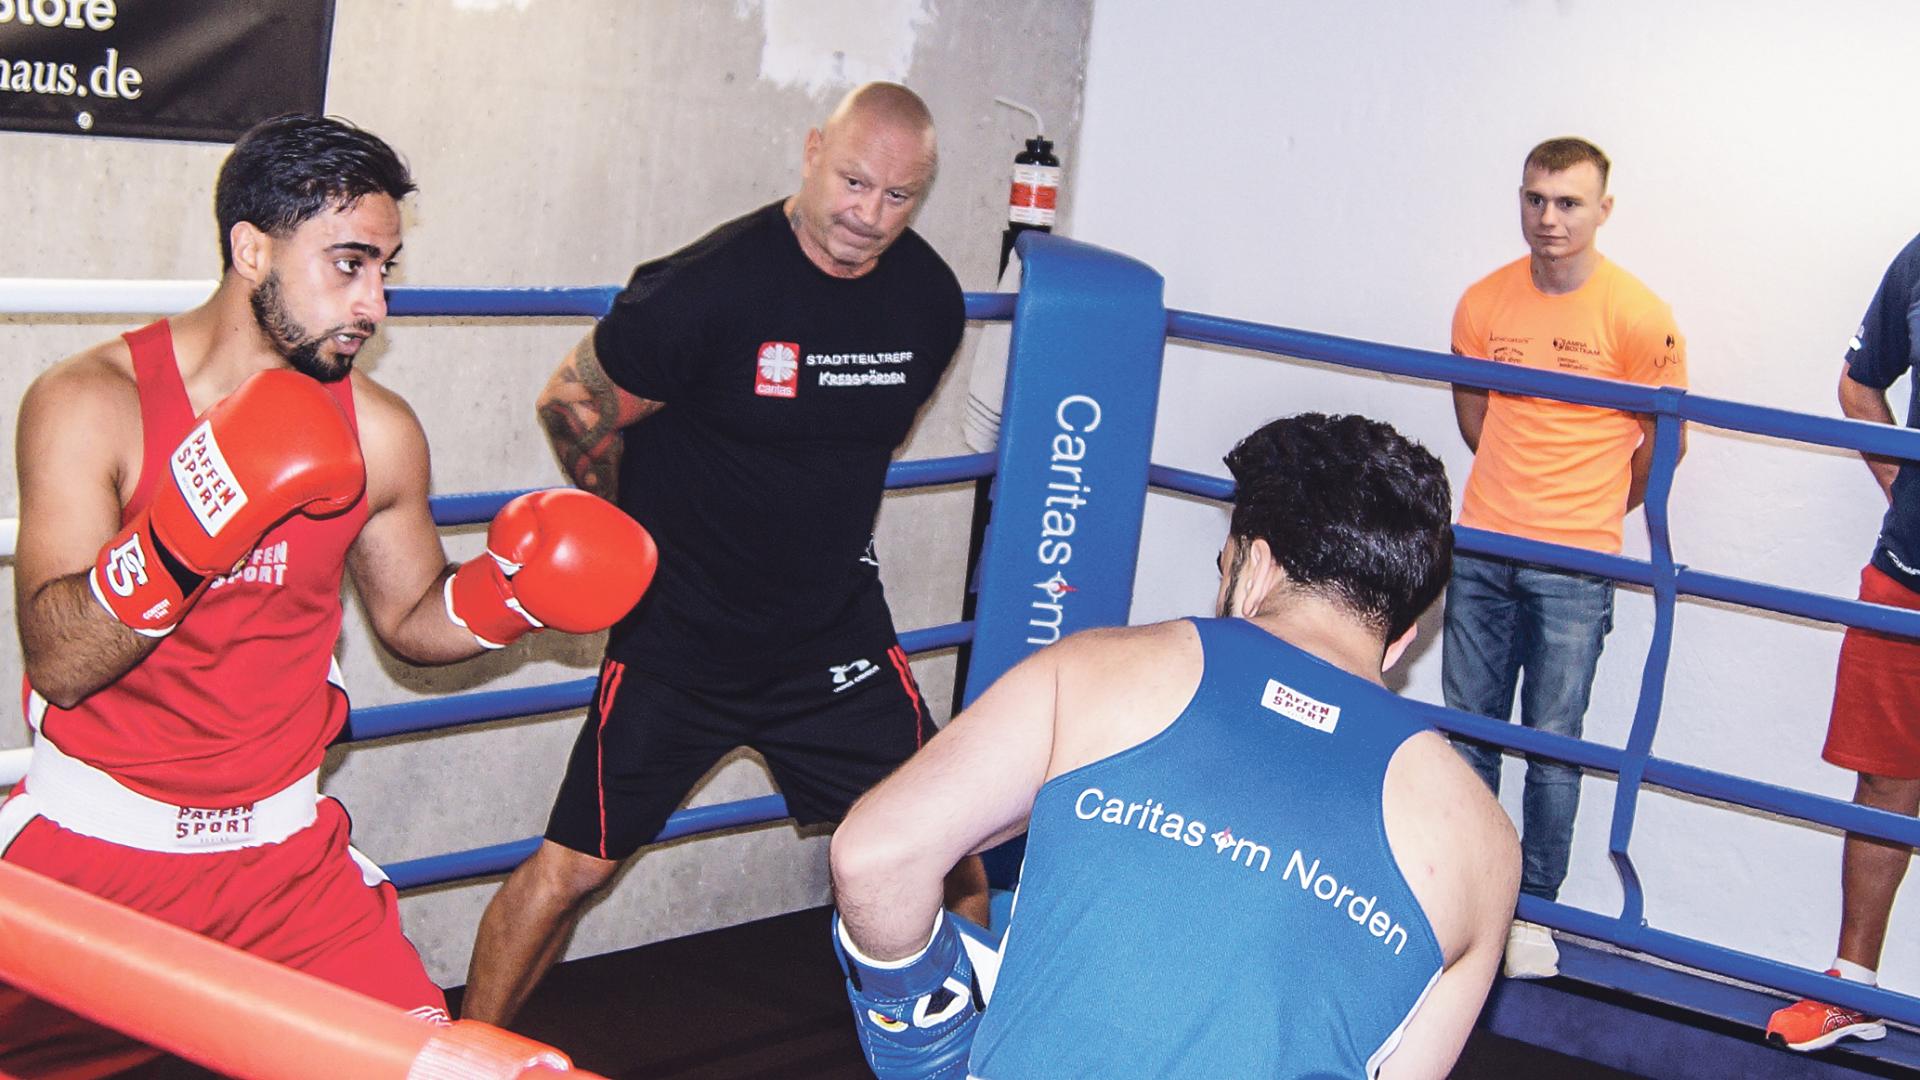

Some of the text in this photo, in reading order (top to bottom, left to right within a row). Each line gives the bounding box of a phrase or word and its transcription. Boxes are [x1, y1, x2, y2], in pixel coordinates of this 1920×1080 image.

[806, 352, 914, 366] STADTTEILTREFF
[177, 446, 222, 519] SPORT
[192, 431, 236, 506] PAFFEN
[1038, 395, 1101, 565] Caritas
[1273, 696, 1326, 724] SPORT
[1277, 686, 1329, 715] PAFFEN
[176, 815, 254, 838] SPORT
[1075, 788, 1206, 848] Caritas
[1282, 850, 1408, 955] Norden
